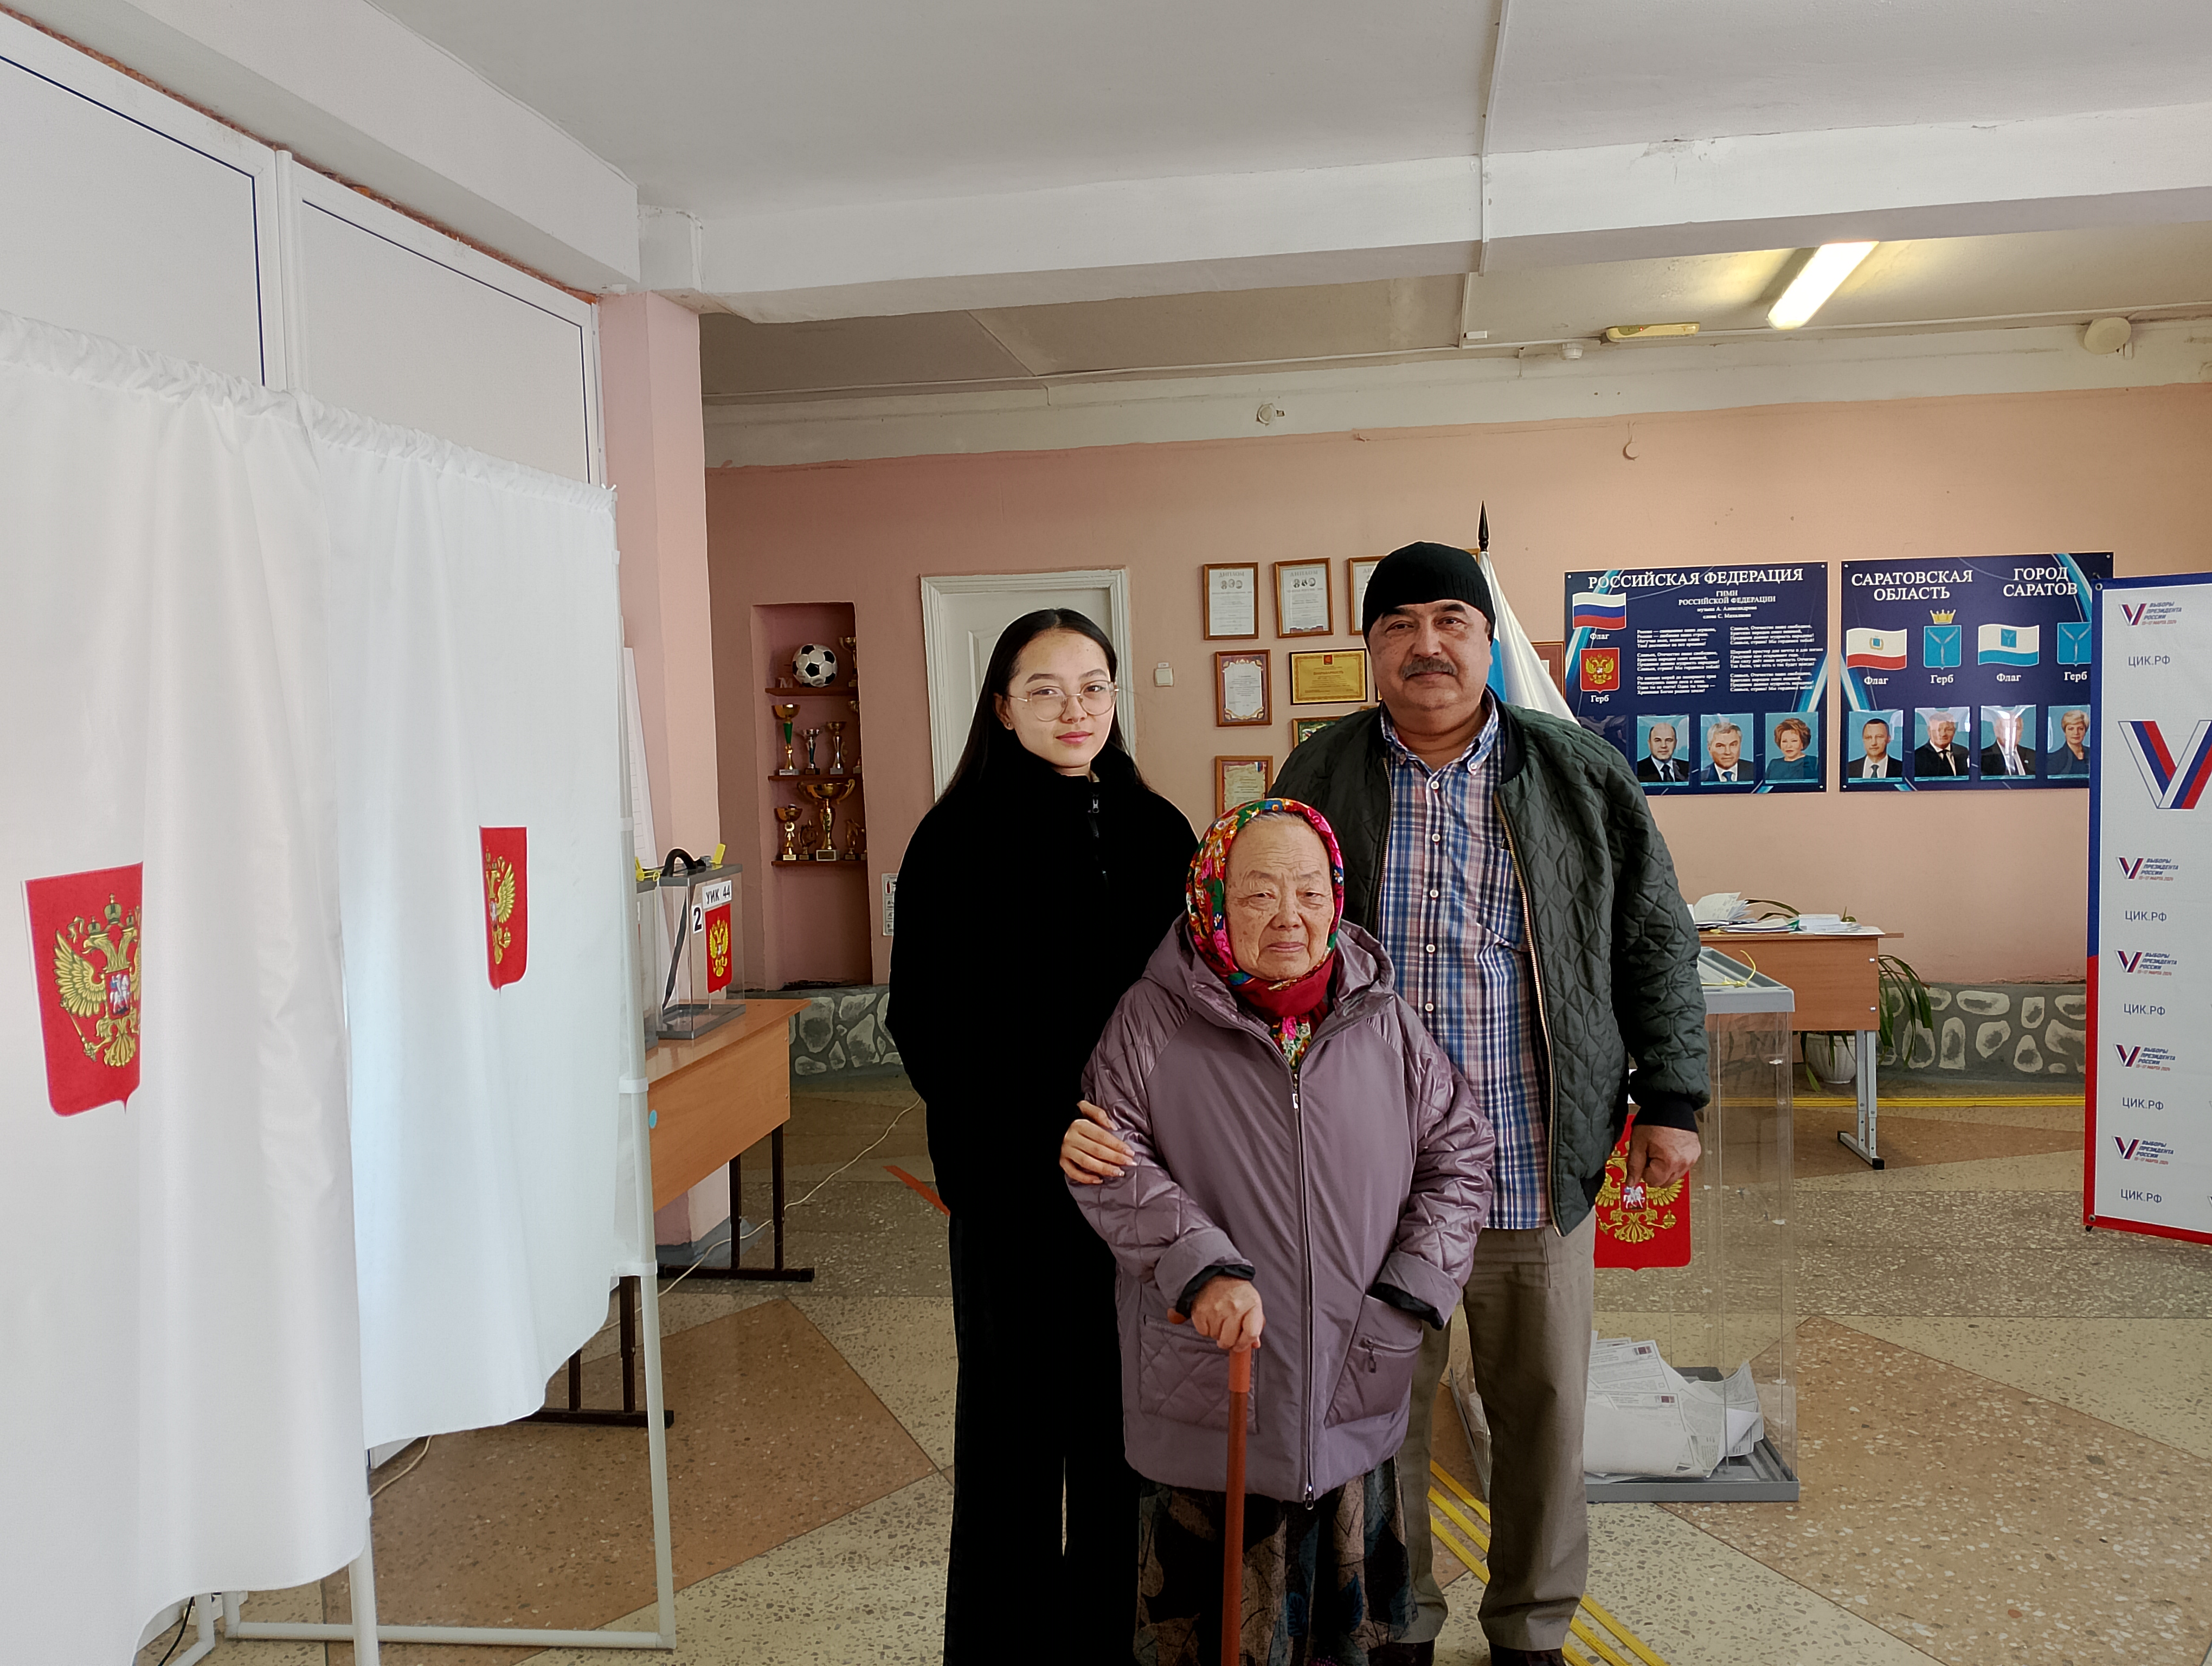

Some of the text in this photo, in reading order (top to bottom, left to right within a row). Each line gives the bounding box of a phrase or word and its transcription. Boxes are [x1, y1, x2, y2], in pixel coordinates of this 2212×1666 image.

[1588, 568, 1803, 589] РОССИЙСКАЯ ФЕДЕРАЦИЯ
[1851, 570, 1973, 586] САРАТОВСКАЯ
[2013, 567, 2068, 582] ГОРОД
[1873, 586, 1950, 601] ОБЛАСТЬ
[2003, 582, 2078, 597] САРАТОВ
[1679, 597, 1729, 605] РОССИЙСКОЙ
[2129, 655, 2170, 668] ЦИК.РФ
[1864, 676, 1888, 685] Флаг
[1931, 674, 1954, 685] Герб
[1996, 673, 2021, 682] Флаг
[2064, 671, 2087, 682] Герб
[1590, 694, 1610, 704] Герб
[706, 885, 730, 905] УИК 44
[693, 907, 702, 932] 2
[2125, 910, 2167, 922] ЦИК.РФ
[2124, 1003, 2165, 1016] ЦИК.РФ
[2123, 1097, 2164, 1110] ЦИК.РФ
[2139, 1146, 2174, 1155] ПРЕЗИДЕНТА
[2121, 1188, 2162, 1203] ЦИК.РФ
